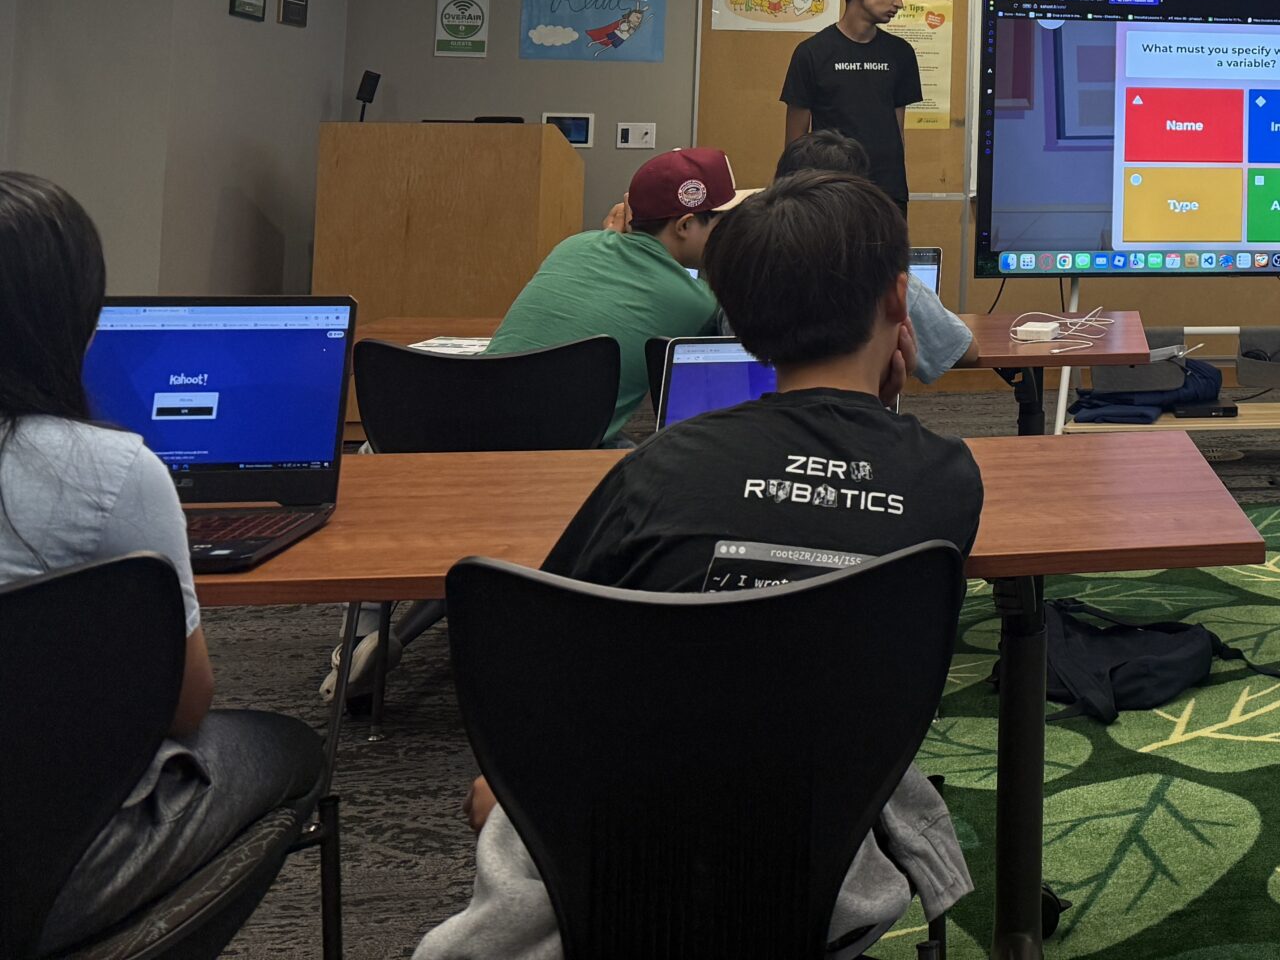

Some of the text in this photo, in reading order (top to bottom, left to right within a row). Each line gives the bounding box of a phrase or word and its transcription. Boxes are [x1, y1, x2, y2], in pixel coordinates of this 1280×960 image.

[909, 4, 925, 13] Tips
[1142, 43, 1173, 54] What
[1176, 45, 1205, 55] must
[1207, 47, 1228, 57] you
[1231, 44, 1272, 58] specify
[1226, 58, 1277, 69] variable?
[1166, 120, 1204, 132] Name
[1167, 200, 1199, 213] Type
[169, 373, 208, 386] Kahoot!
